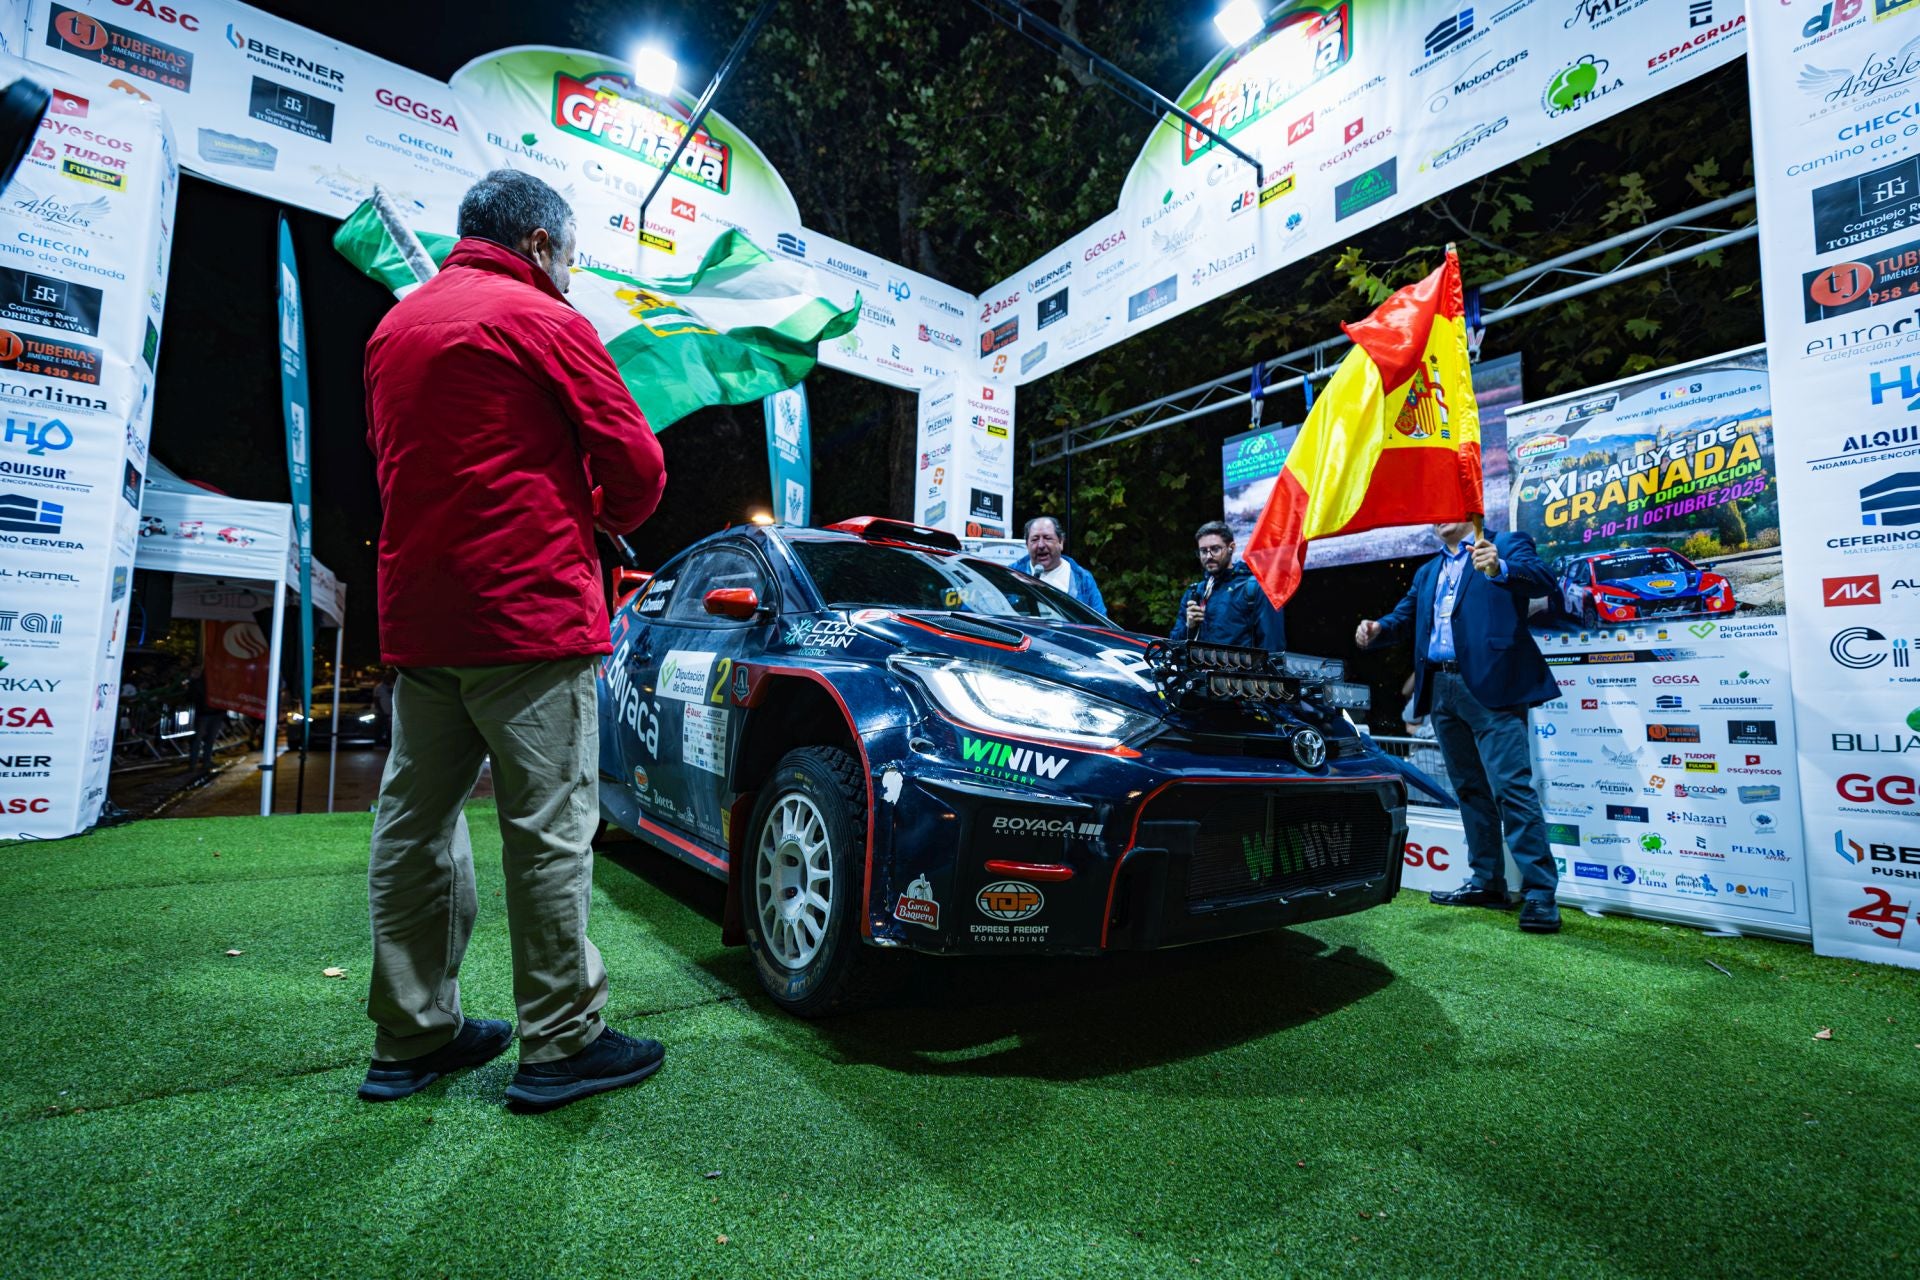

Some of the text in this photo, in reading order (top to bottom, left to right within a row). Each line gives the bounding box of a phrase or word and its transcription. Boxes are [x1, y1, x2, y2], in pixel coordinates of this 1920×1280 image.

[247, 38, 345, 84] BERNER
[1410, 26, 1491, 77] CEFERINO CERVERA
[100, 54, 186, 90] 958 430 440
[246, 53, 344, 93] PUSHING THE LIMITS
[1454, 49, 1529, 96] MotorCars
[63, 143, 126, 169] TUDOR
[1319, 126, 1393, 172] escayescos
[1786, 134, 1898, 177] Camino de
[69, 164, 115, 183] FULMEN
[1843, 207, 1906, 234] Complejo
[1826, 219, 1905, 250] TORRES &
[39, 253, 125, 281] de Granada
[1034, 261, 1072, 288] BERNER
[1868, 286, 1903, 304] 958
[26, 340, 96, 364] TUBERIAS
[16, 361, 96, 384] 958 430 440
[1616, 383, 1762, 422] www.rallyeciudaddegranada.es
[1543, 420, 1739, 505] XI RALLYE DE
[1543, 434, 1762, 528] GRANADA
[1627, 459, 1762, 512] BY DIPUTACIÓN
[1583, 477, 1765, 543] 9-10-11 OCTUBRE 2025
[22, 537, 85, 550] CERVERA
[1843, 544, 1904, 555] MATERIALES
[1720, 623, 1774, 632] Diputación
[1734, 630, 1778, 638] Granada
[803, 634, 855, 649] CHAIN
[675, 668, 705, 683] Diputación
[711, 657, 732, 704] 2
[607, 639, 661, 761] Boyacá
[680, 682, 704, 698] Granada
[1712, 697, 1758, 705] ALQUISUR
[1571, 726, 1623, 735] euroclima
[963, 736, 1069, 780] WINIW
[1684, 752, 1716, 760] TUDOR
[974, 766, 1037, 786] DELIVERY
[1727, 767, 1782, 775] escayescos
[1838, 806, 1901, 816] GRANADA EVENTOS
[992, 816, 1075, 834] BOYACA
[1033, 831, 1101, 842] RECICLAJE
[1731, 845, 1785, 858] PLEMAR
[1638, 878, 1667, 888] Luna
[907, 899, 931, 913] García
[980, 892, 1039, 912] TOP
[899, 907, 935, 923] Baquero
[1848, 918, 1875, 929] años
[970, 925, 1050, 935] EXPRESS FREIGHT
[974, 935, 1046, 943] FORWARDING
